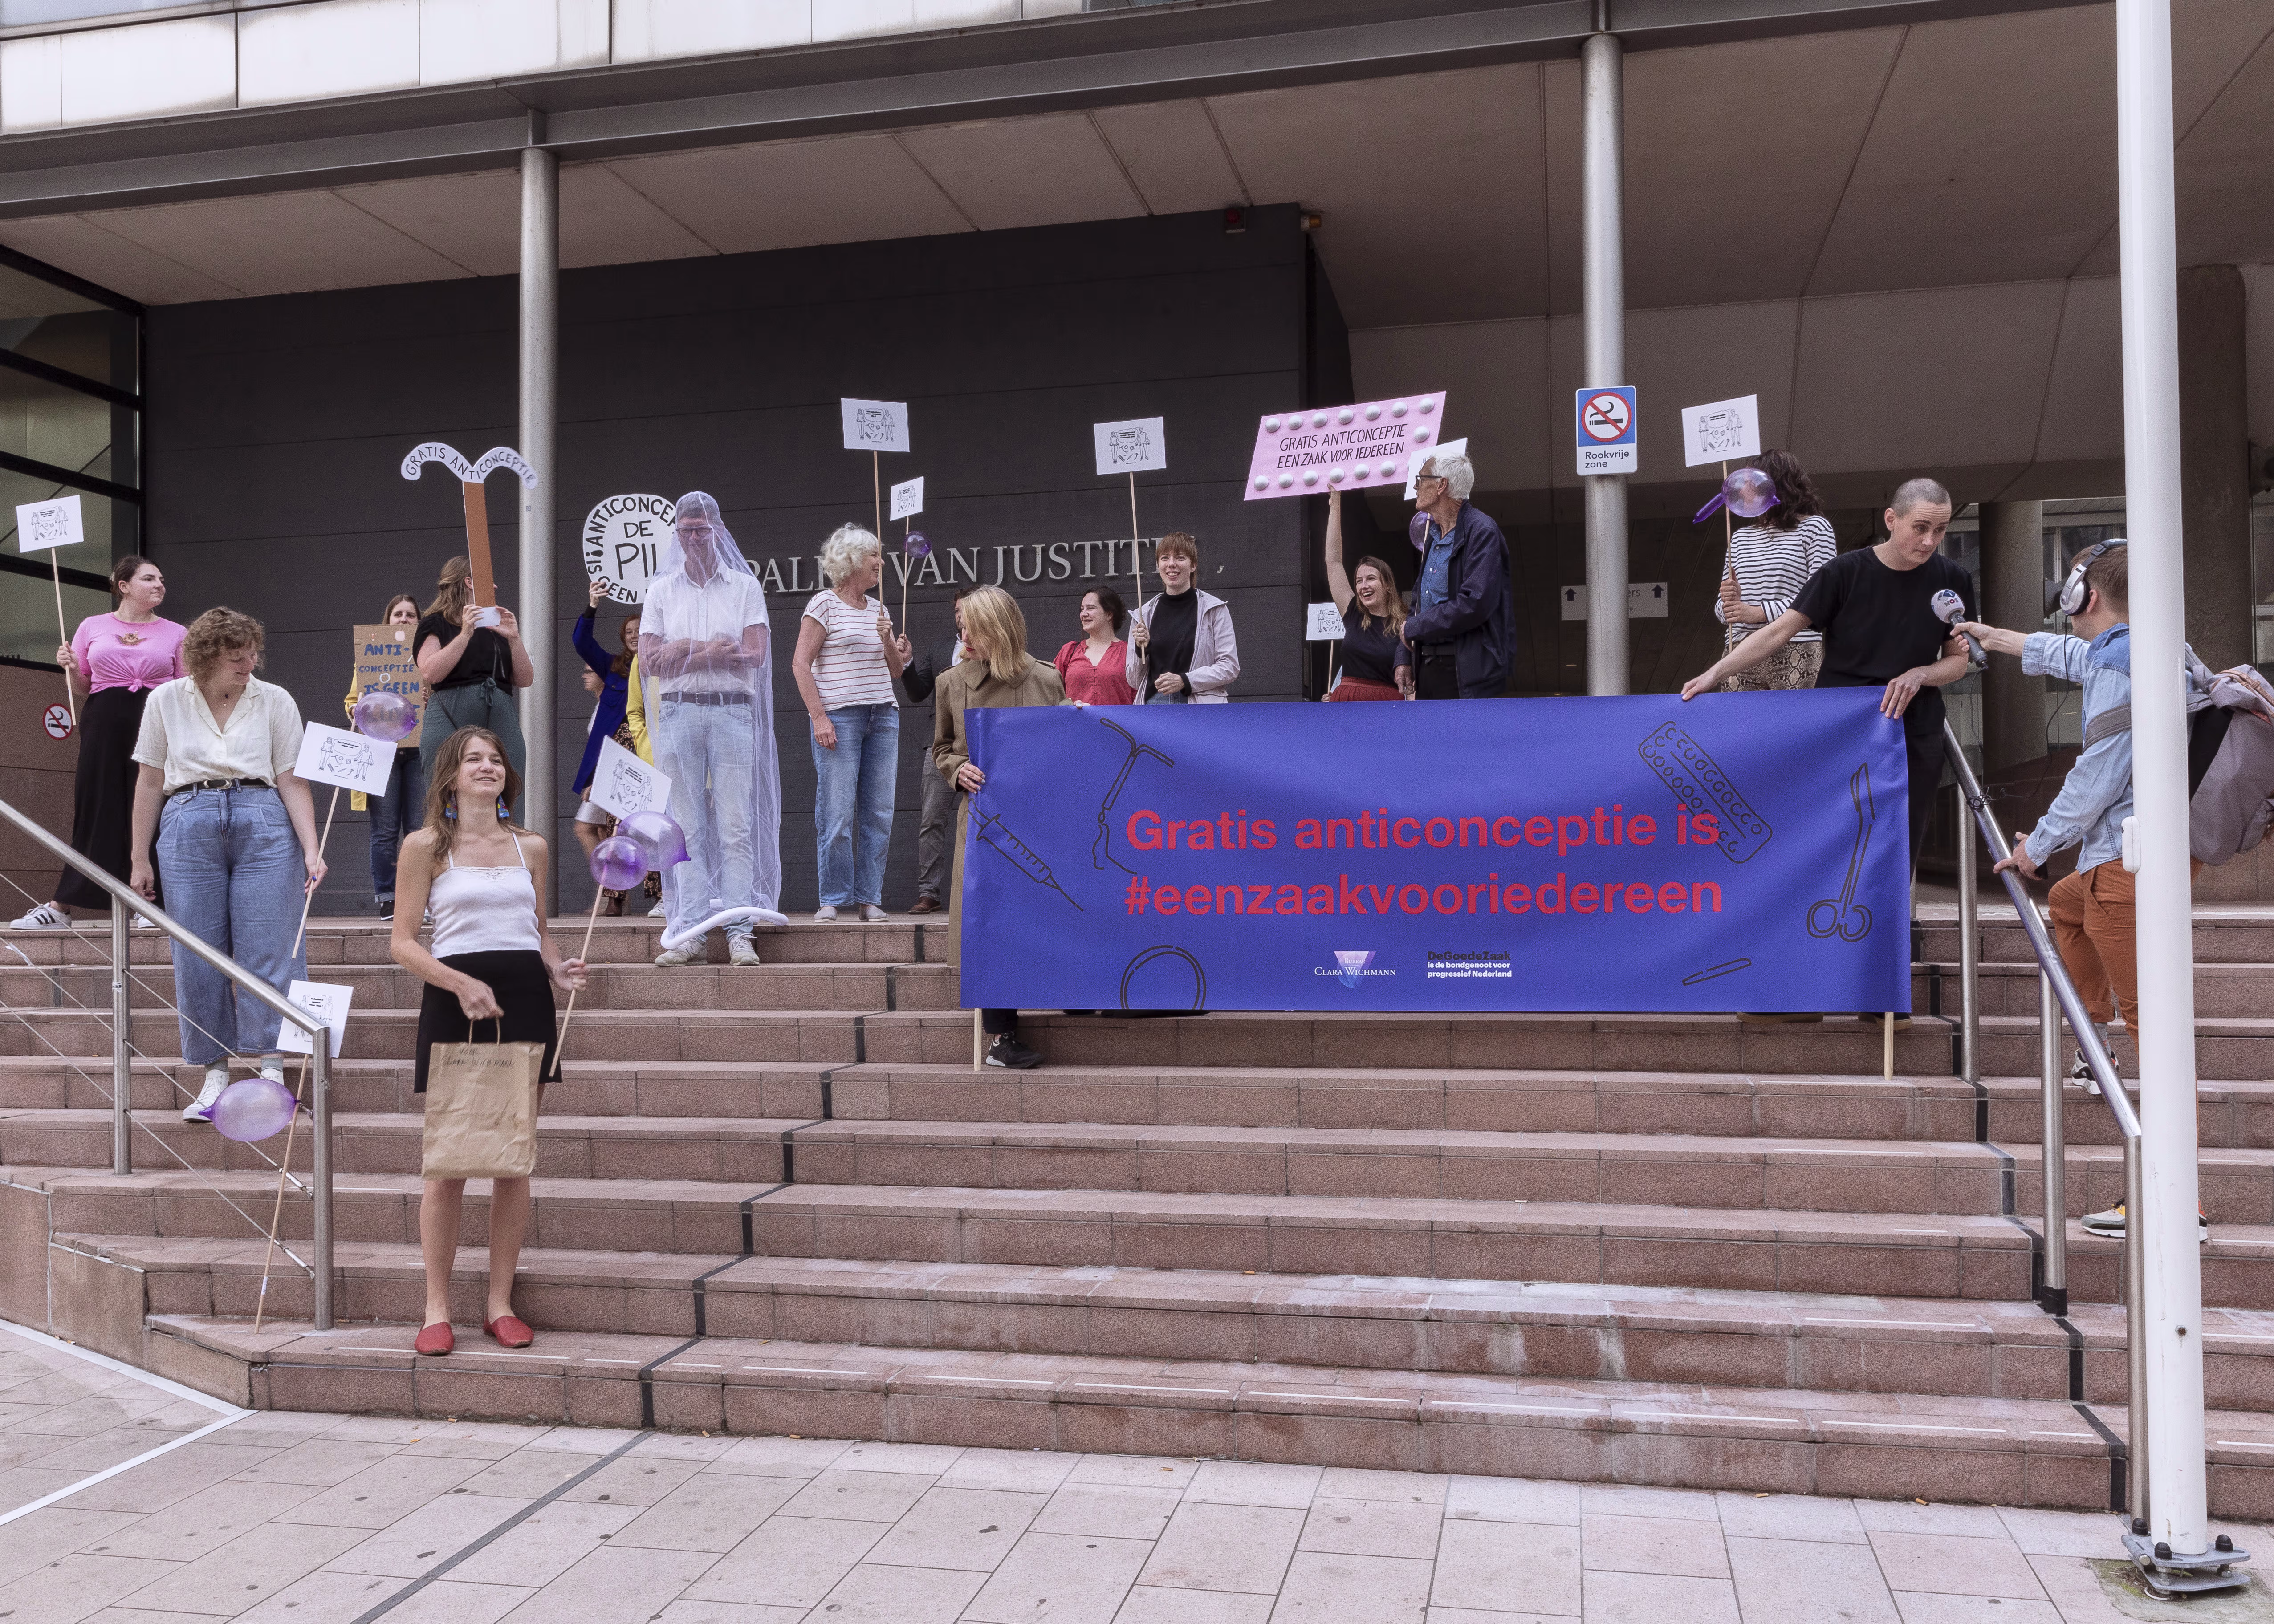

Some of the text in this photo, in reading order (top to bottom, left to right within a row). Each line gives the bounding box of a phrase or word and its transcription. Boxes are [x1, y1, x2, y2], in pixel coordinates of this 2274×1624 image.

[1280, 424, 1408, 451] GRATIS ANTICONCEPTIE
[1277, 442, 1404, 468] EEN ZAAK VOOR IEDEREEN
[1585, 450, 1629, 459] Rookvrije
[406, 446, 536, 484] GRATIS ANTICONCEPTIE
[624, 520, 654, 538] DE
[887, 547, 981, 586] VAN
[1944, 598, 1959, 607] NOS
[364, 643, 410, 656] ANTI-
[358, 664, 415, 673] CONCEPTIE
[383, 682, 420, 695] GEEN
[1127, 804, 1719, 856] Gratis anticonceptie is
[1125, 873, 1721, 915] #eenzaakvooriedereen
[1428, 951, 1511, 961] DeGoedeZaak
